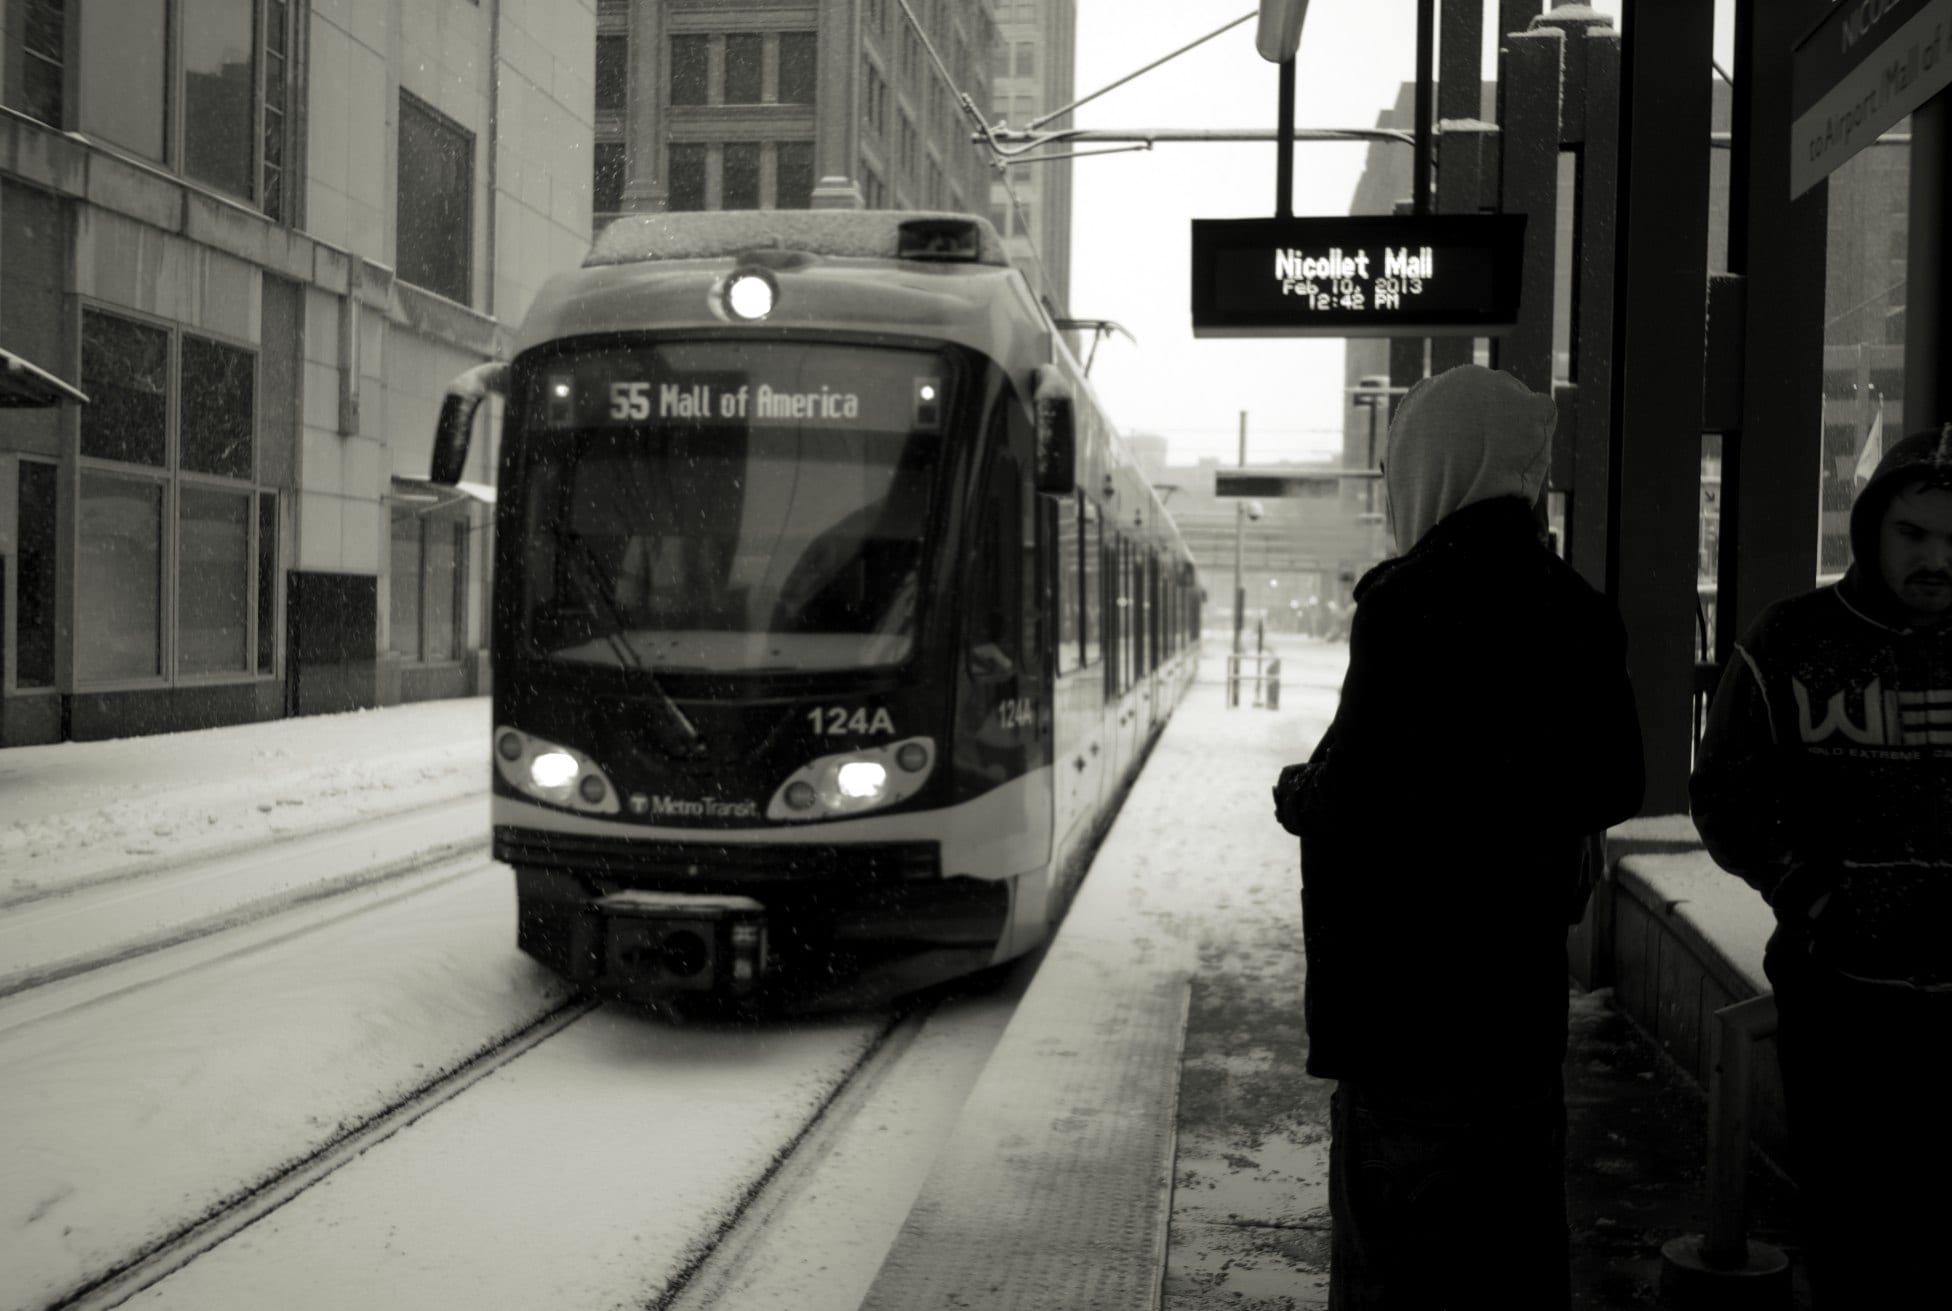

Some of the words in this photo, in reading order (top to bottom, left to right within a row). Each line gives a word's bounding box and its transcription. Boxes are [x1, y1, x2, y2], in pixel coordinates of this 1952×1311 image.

[1809, 135, 1824, 162] to
[1275, 248, 1369, 280] Nicollet
[1385, 247, 1432, 278] Mall
[1282, 279, 1318, 295] Feb
[1332, 279, 1361, 295] 10,
[1375, 278, 1422, 294] 2013
[1310, 294, 1365, 310] 12:42
[1375, 294, 1399, 310] PM
[610, 382, 650, 419] 55
[660, 384, 711, 418] Mall
[720, 385, 748, 418] of
[757, 383, 858, 418] America
[808, 707, 895, 735] 124A
[999, 698, 1032, 729] 124A
